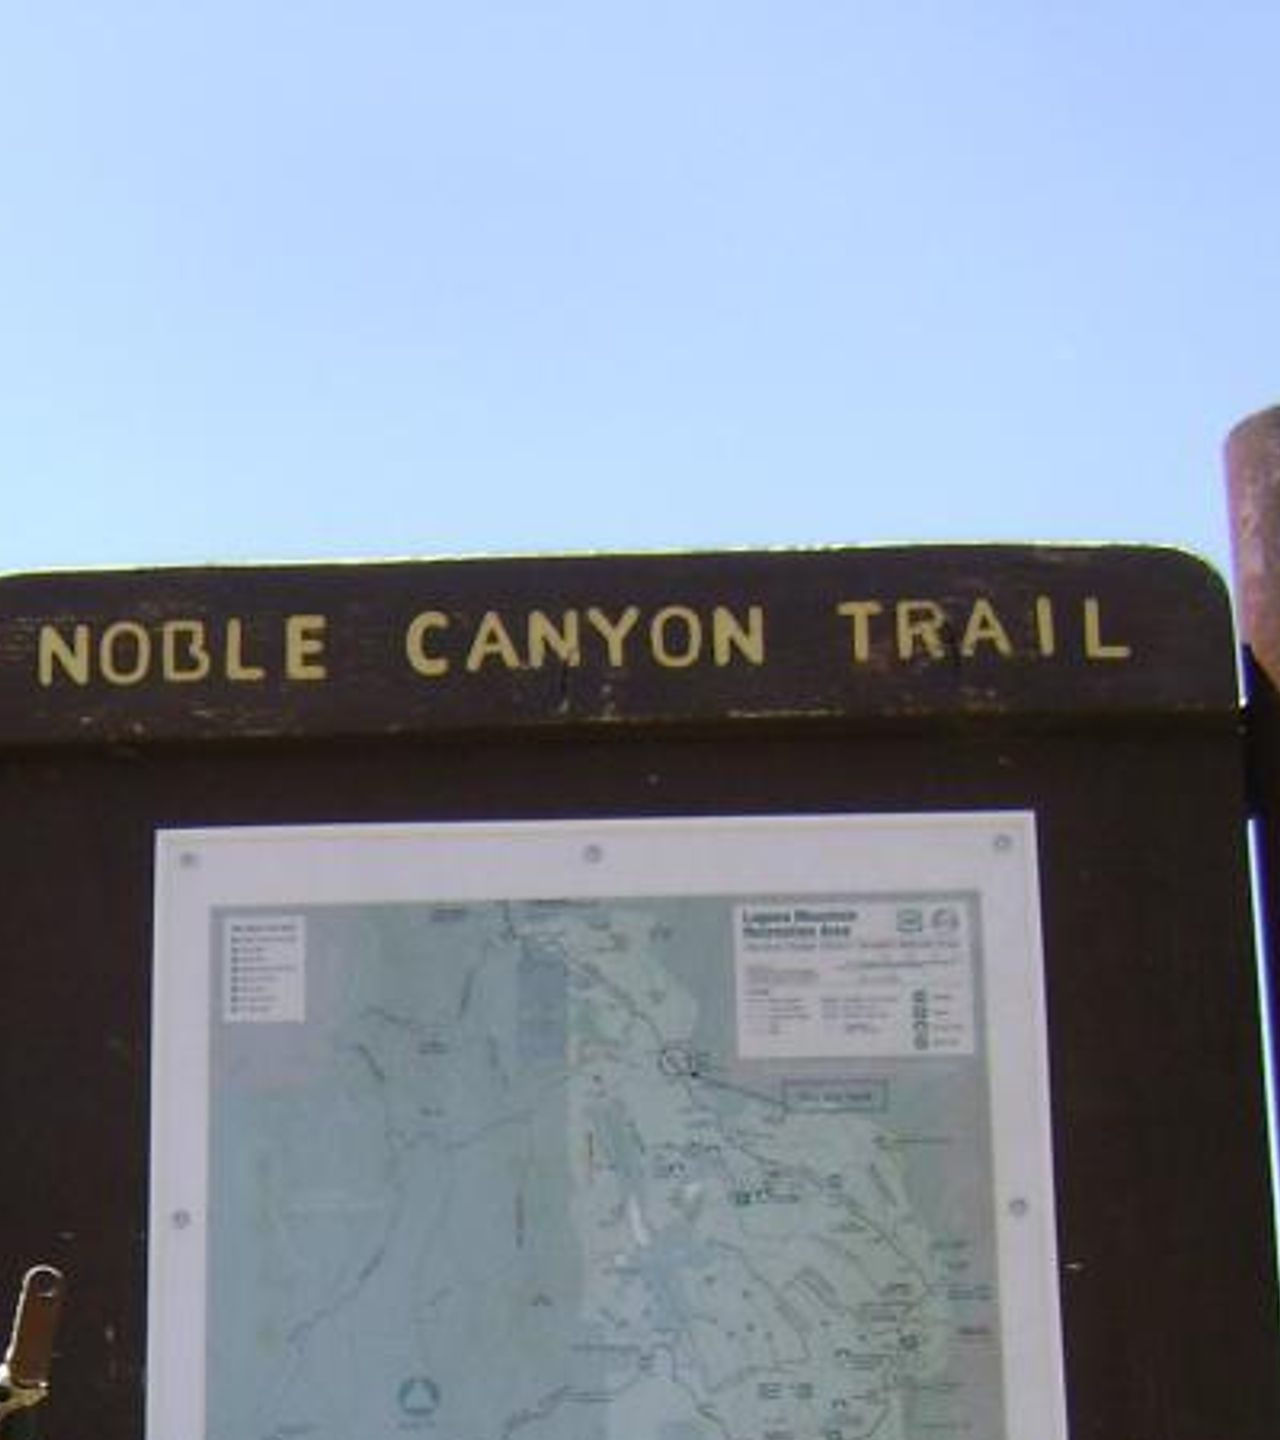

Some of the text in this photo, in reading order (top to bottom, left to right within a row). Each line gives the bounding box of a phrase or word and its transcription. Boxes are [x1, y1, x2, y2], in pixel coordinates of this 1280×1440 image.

[37, 597, 1132, 685] NOBLE CANYON TRAIL
